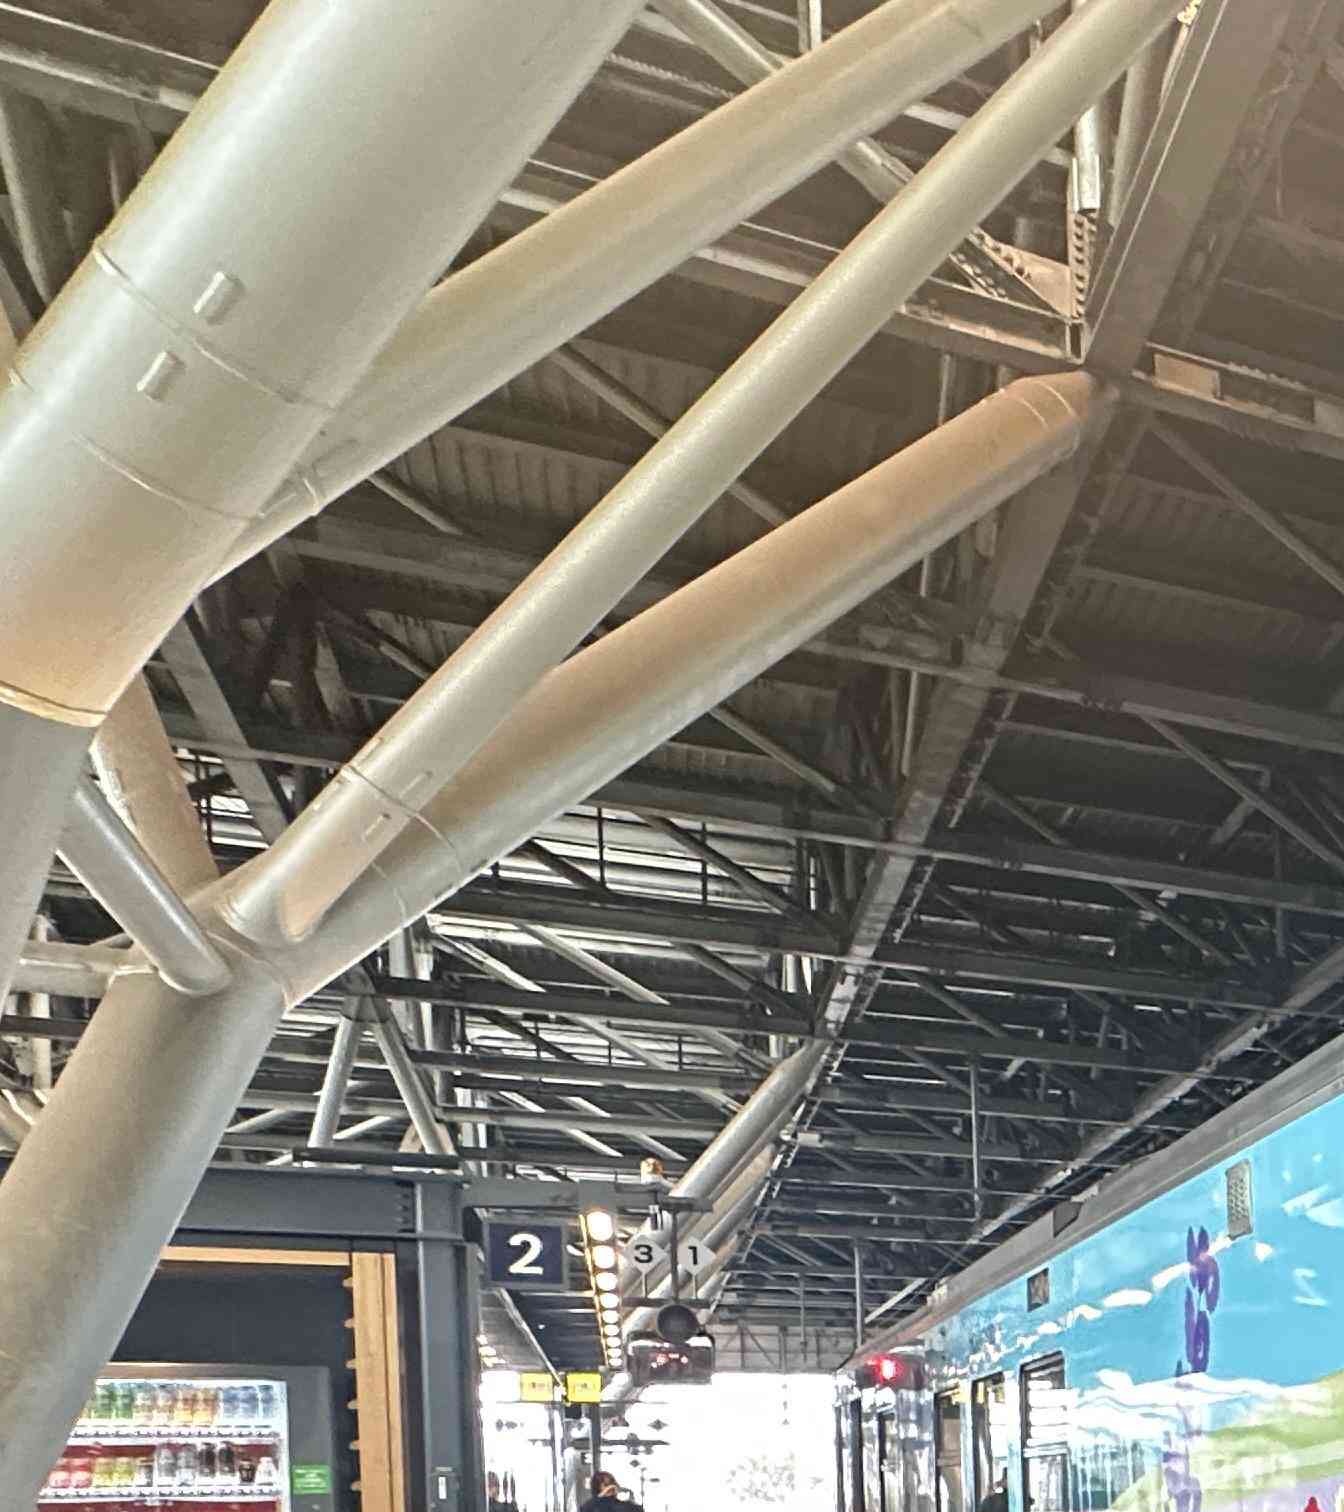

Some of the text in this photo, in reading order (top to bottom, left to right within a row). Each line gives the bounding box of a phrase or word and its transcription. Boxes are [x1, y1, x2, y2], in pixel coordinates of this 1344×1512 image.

[507, 1233, 545, 1276] 2
[634, 1244, 653, 1264] 3
[688, 1245, 699, 1265] 1
